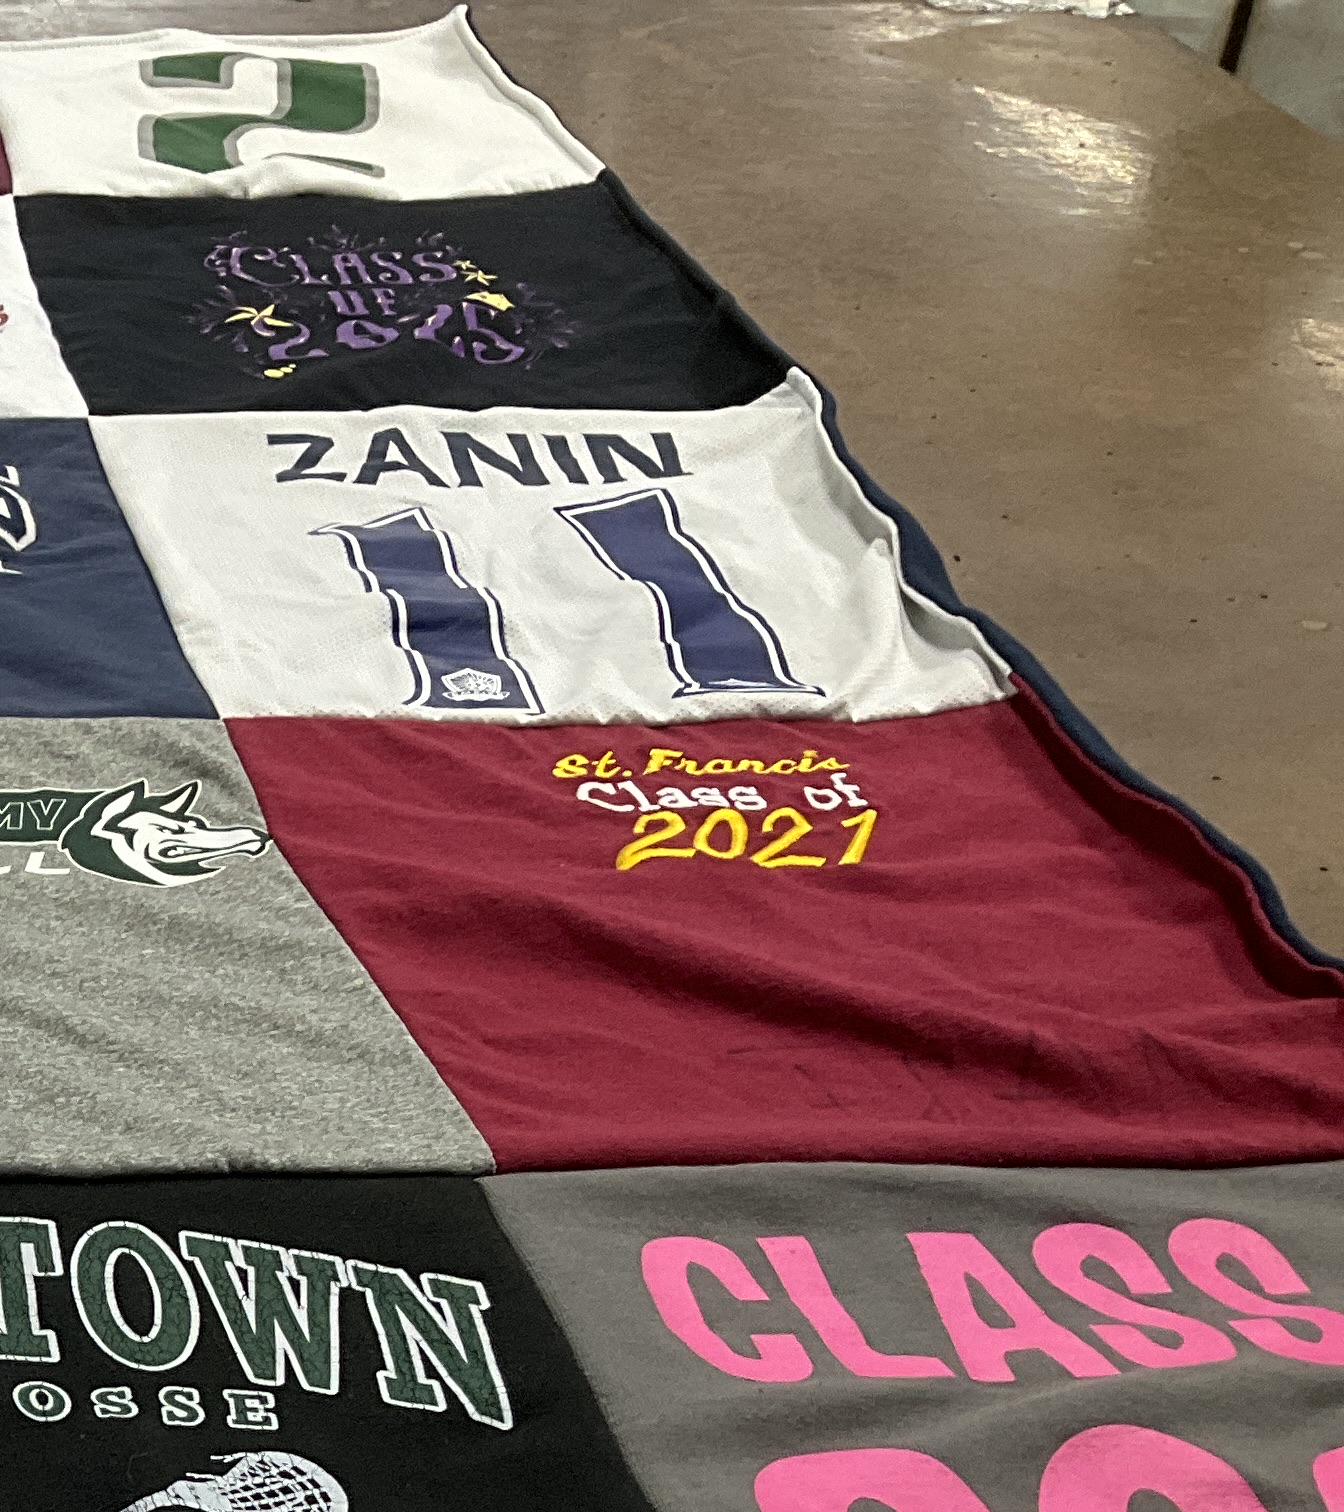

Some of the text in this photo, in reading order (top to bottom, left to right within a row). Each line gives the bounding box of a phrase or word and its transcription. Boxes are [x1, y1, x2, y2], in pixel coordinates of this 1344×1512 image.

[138, 50, 386, 178] 2
[228, 246, 458, 288] CLASS
[265, 427, 695, 490] ZANIN
[306, 488, 828, 718] 11
[551, 746, 853, 780] St. Francis
[575, 772, 869, 813] Class of
[614, 807, 880, 872] 2021
[640, 1216, 1344, 1384] CLASS
